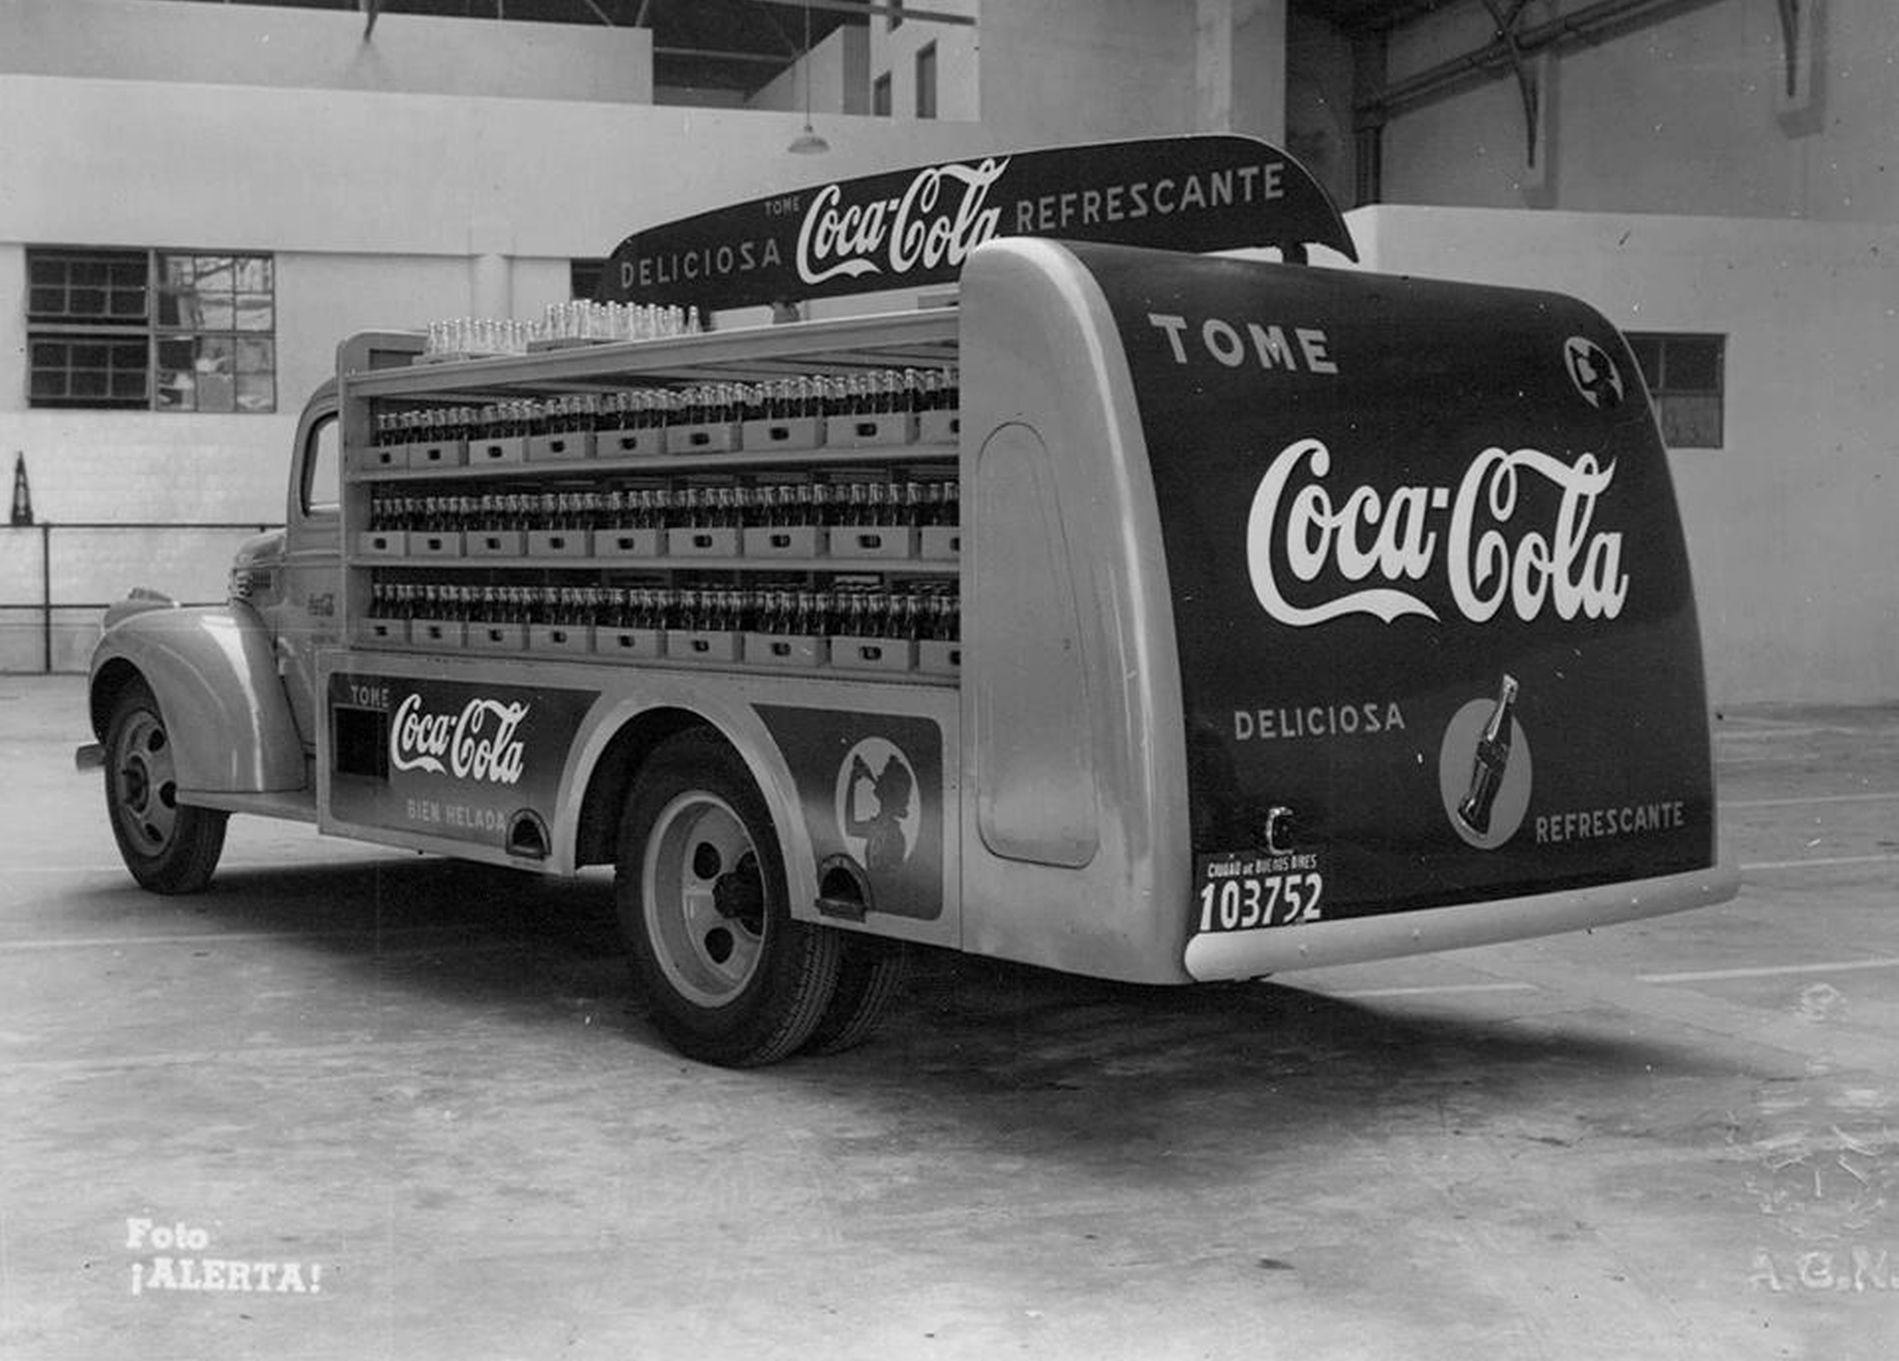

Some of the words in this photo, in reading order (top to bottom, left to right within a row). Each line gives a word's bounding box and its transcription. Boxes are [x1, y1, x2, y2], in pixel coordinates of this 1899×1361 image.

[620, 237, 782, 289] DELICIOSA
[796, 157, 1011, 282] Coca-Cola
[1016, 162, 1285, 233] REFRESCANTE
[764, 196, 801, 216] TOME
[1148, 313, 1338, 374] TOME
[1246, 438, 1629, 627] Coca-Cola
[350, 685, 390, 708] TOME
[1234, 702, 1406, 741] DELICIOSA
[390, 693, 531, 784] Coca-Cola
[407, 798, 441, 823] BIEN
[446, 804, 507, 833] HELADA
[1535, 801, 1685, 844] REFRESCANTE
[1201, 873, 1322, 931] 103752
